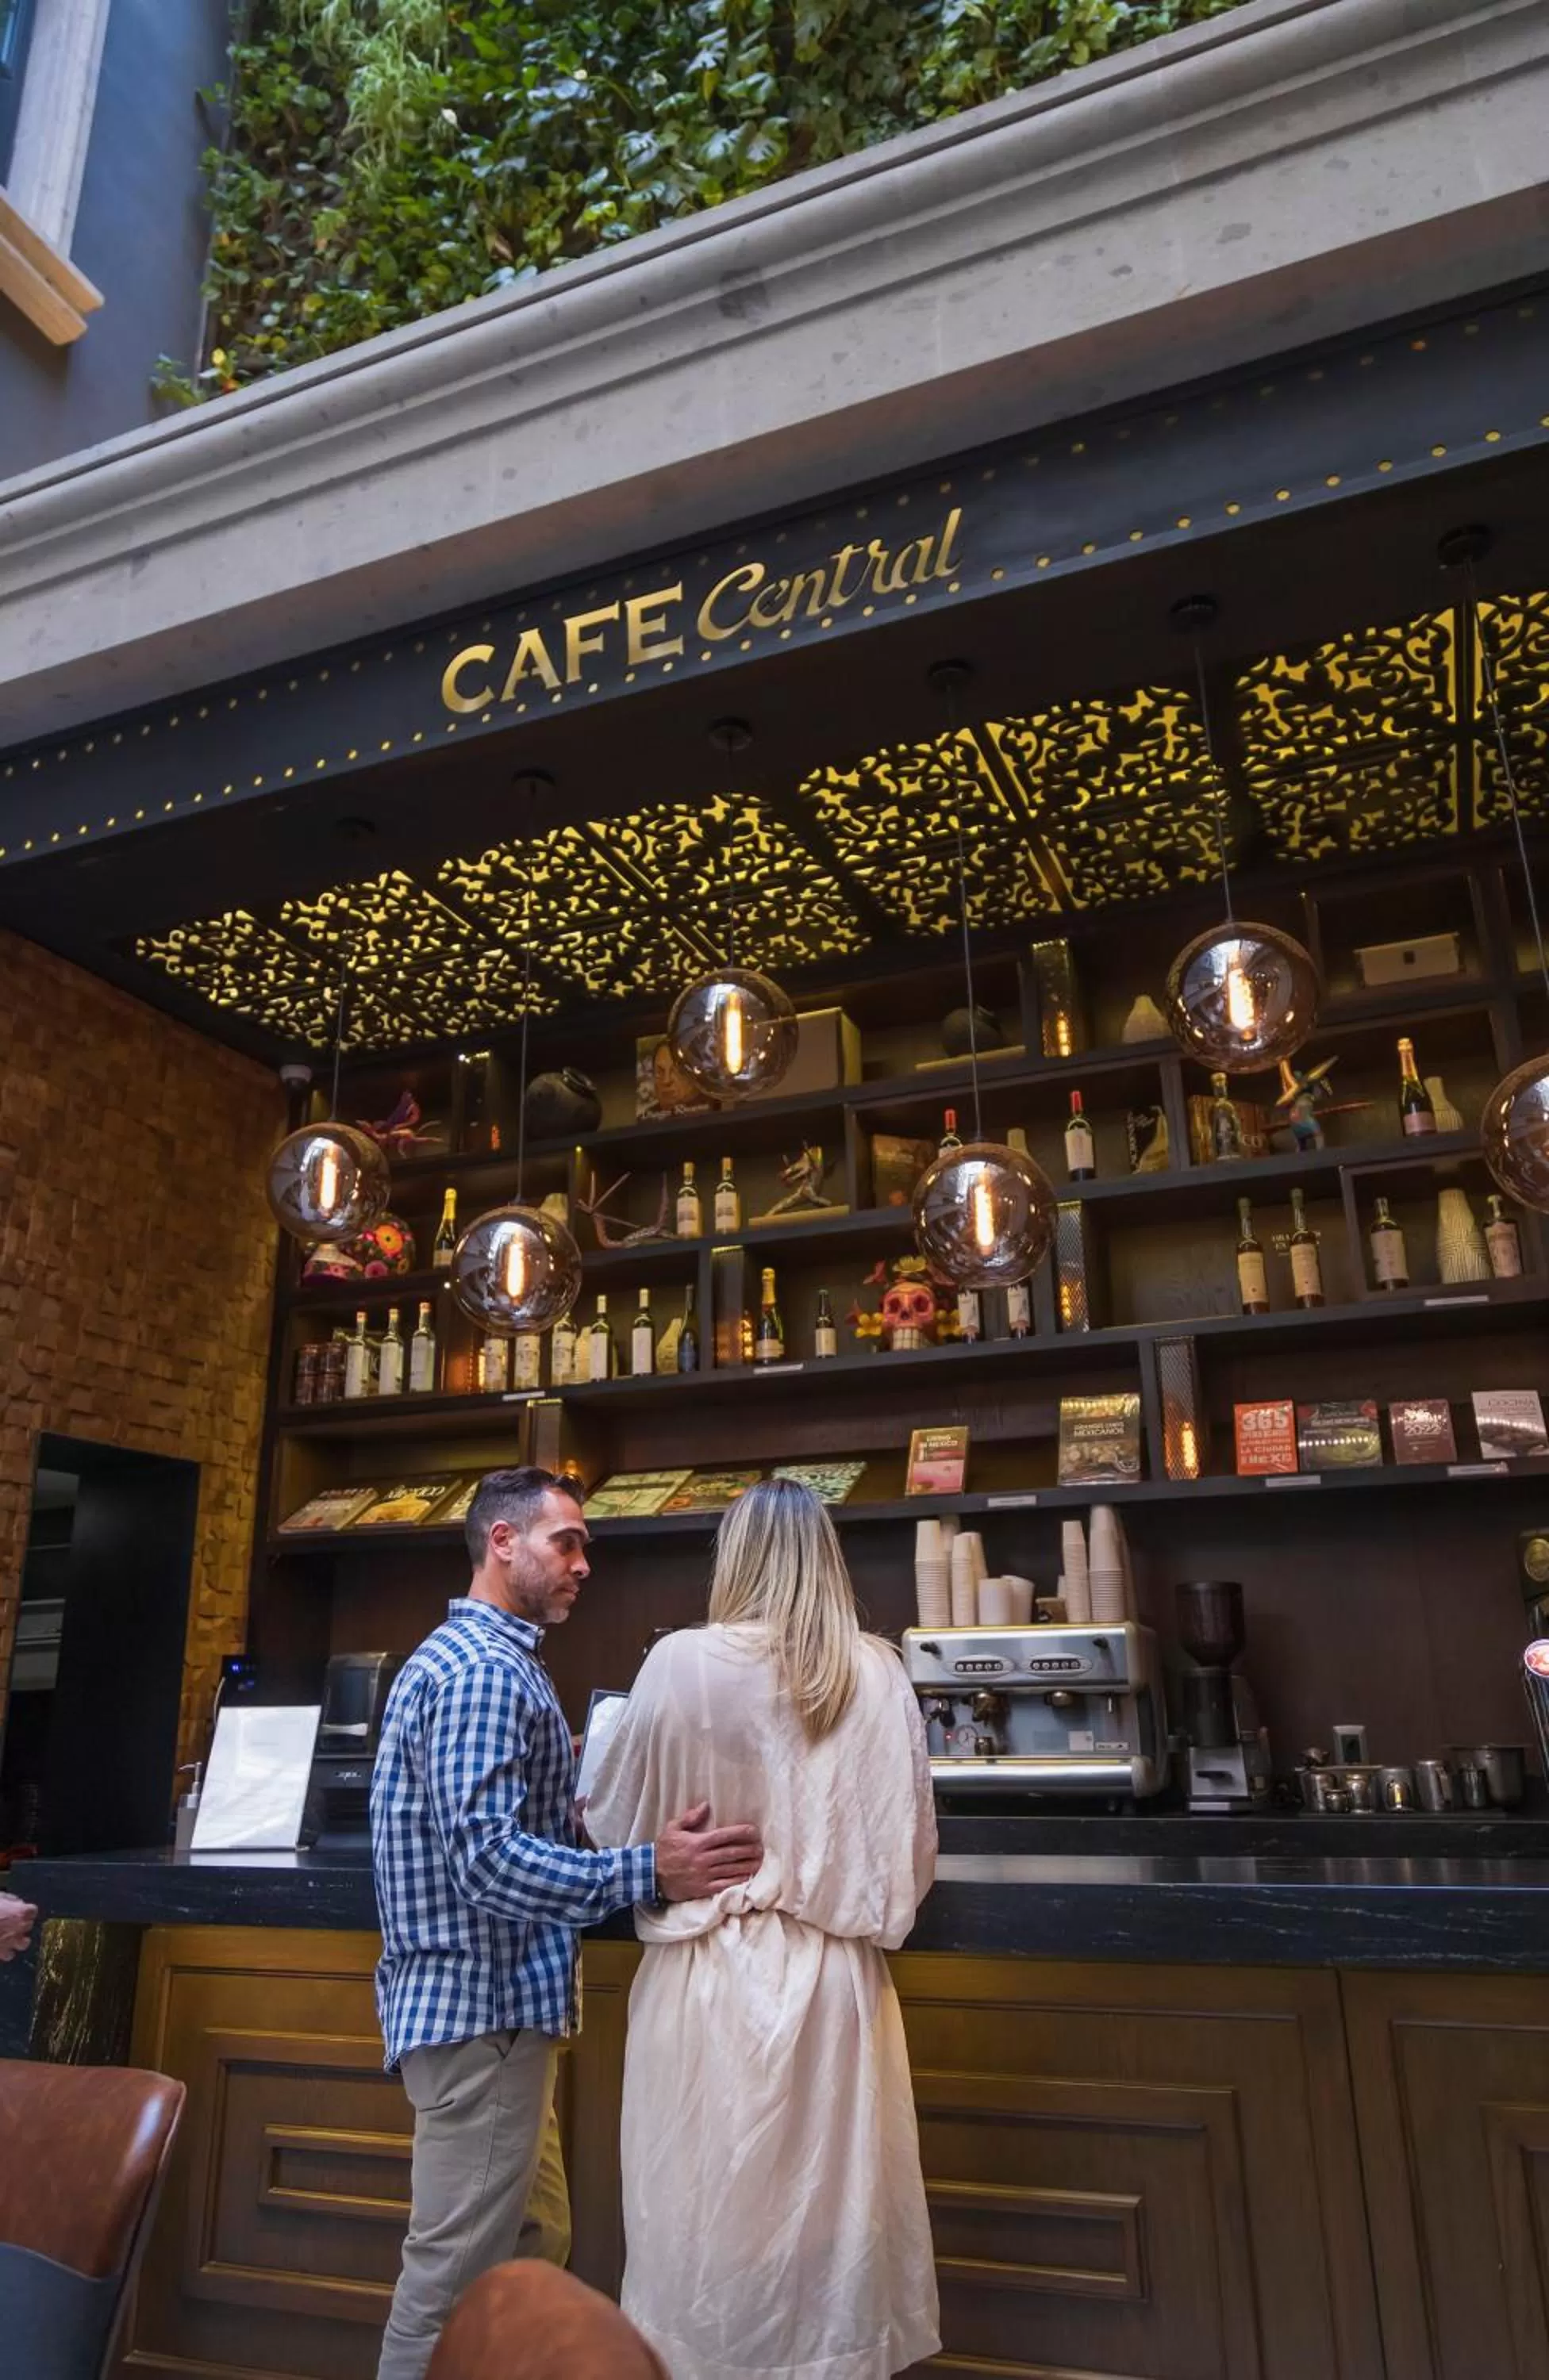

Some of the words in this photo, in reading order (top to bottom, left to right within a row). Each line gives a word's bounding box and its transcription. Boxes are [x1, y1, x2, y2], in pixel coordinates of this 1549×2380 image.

[441, 580, 684, 713] CAFE
[696, 508, 963, 641] Central
[1242, 1410, 1289, 1431] 365
[1404, 1423, 1442, 1437] 2022
